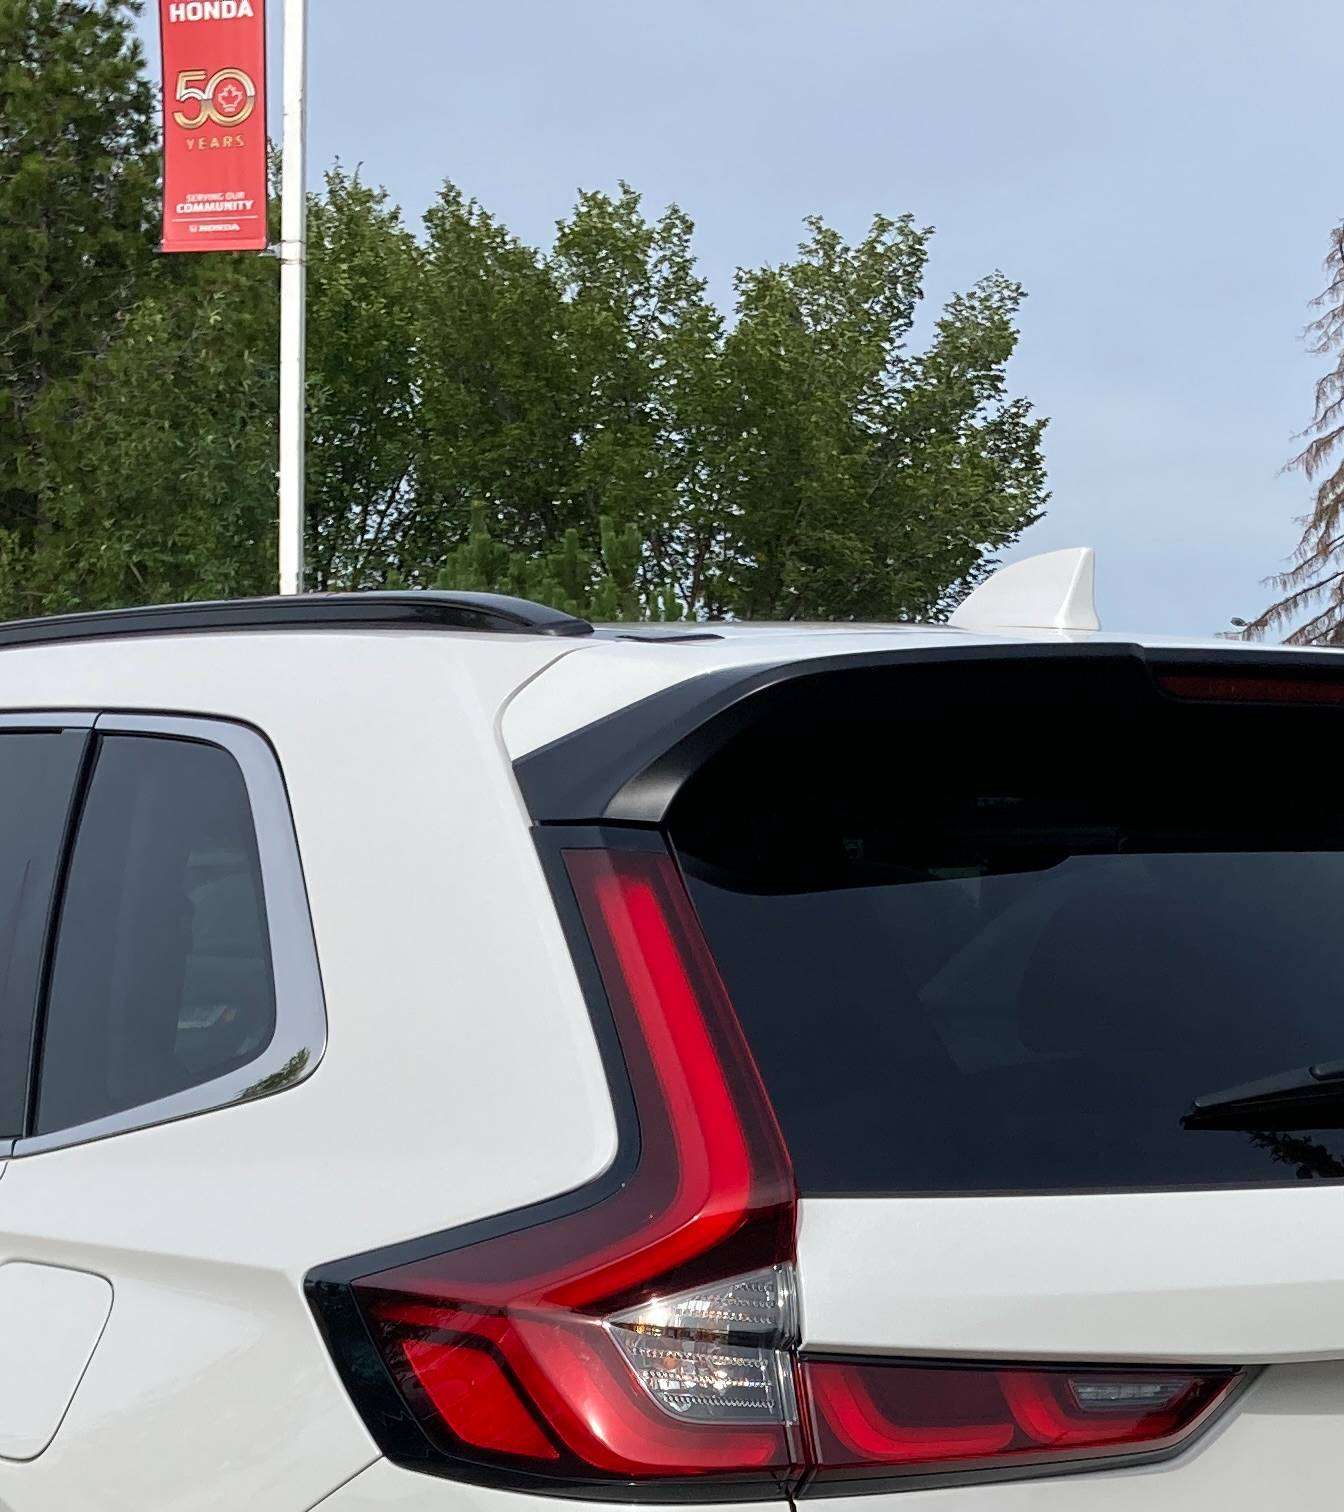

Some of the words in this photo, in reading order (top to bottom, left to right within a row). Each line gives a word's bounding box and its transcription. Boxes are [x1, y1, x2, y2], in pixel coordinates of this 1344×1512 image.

[169, 0, 254, 22] HONDA
[173, 68, 256, 129] 50
[186, 135, 245, 150] YEARS
[176, 200, 254, 214] COMMUNITY
